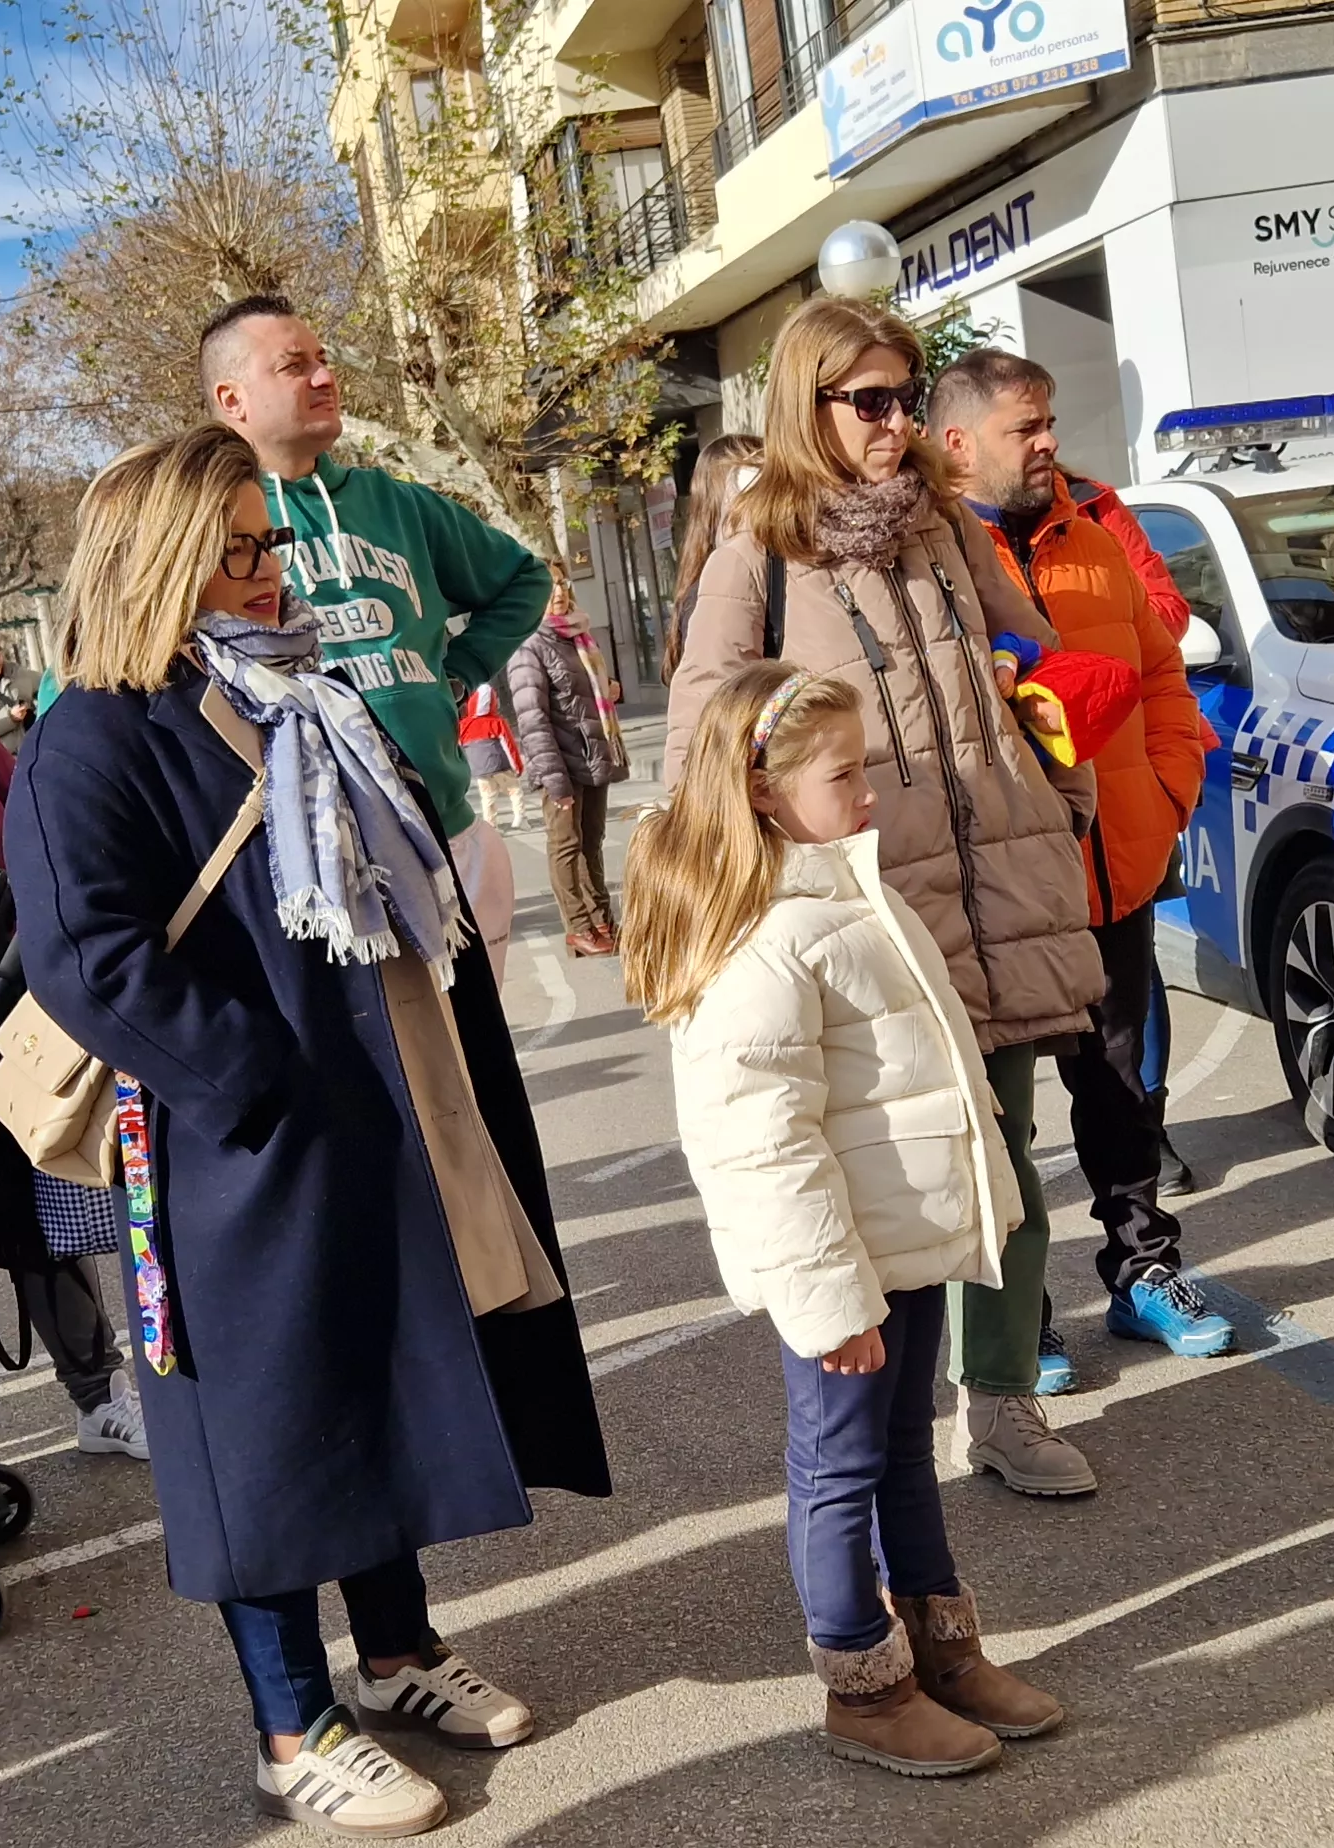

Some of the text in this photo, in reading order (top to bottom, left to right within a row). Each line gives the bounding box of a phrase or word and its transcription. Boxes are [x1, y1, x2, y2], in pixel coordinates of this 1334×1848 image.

[989, 30, 1100, 68] formando personas
[951, 58, 1099, 107] Tel. +34 974 238 238
[1253, 256, 1331, 277] Rejuvenece
